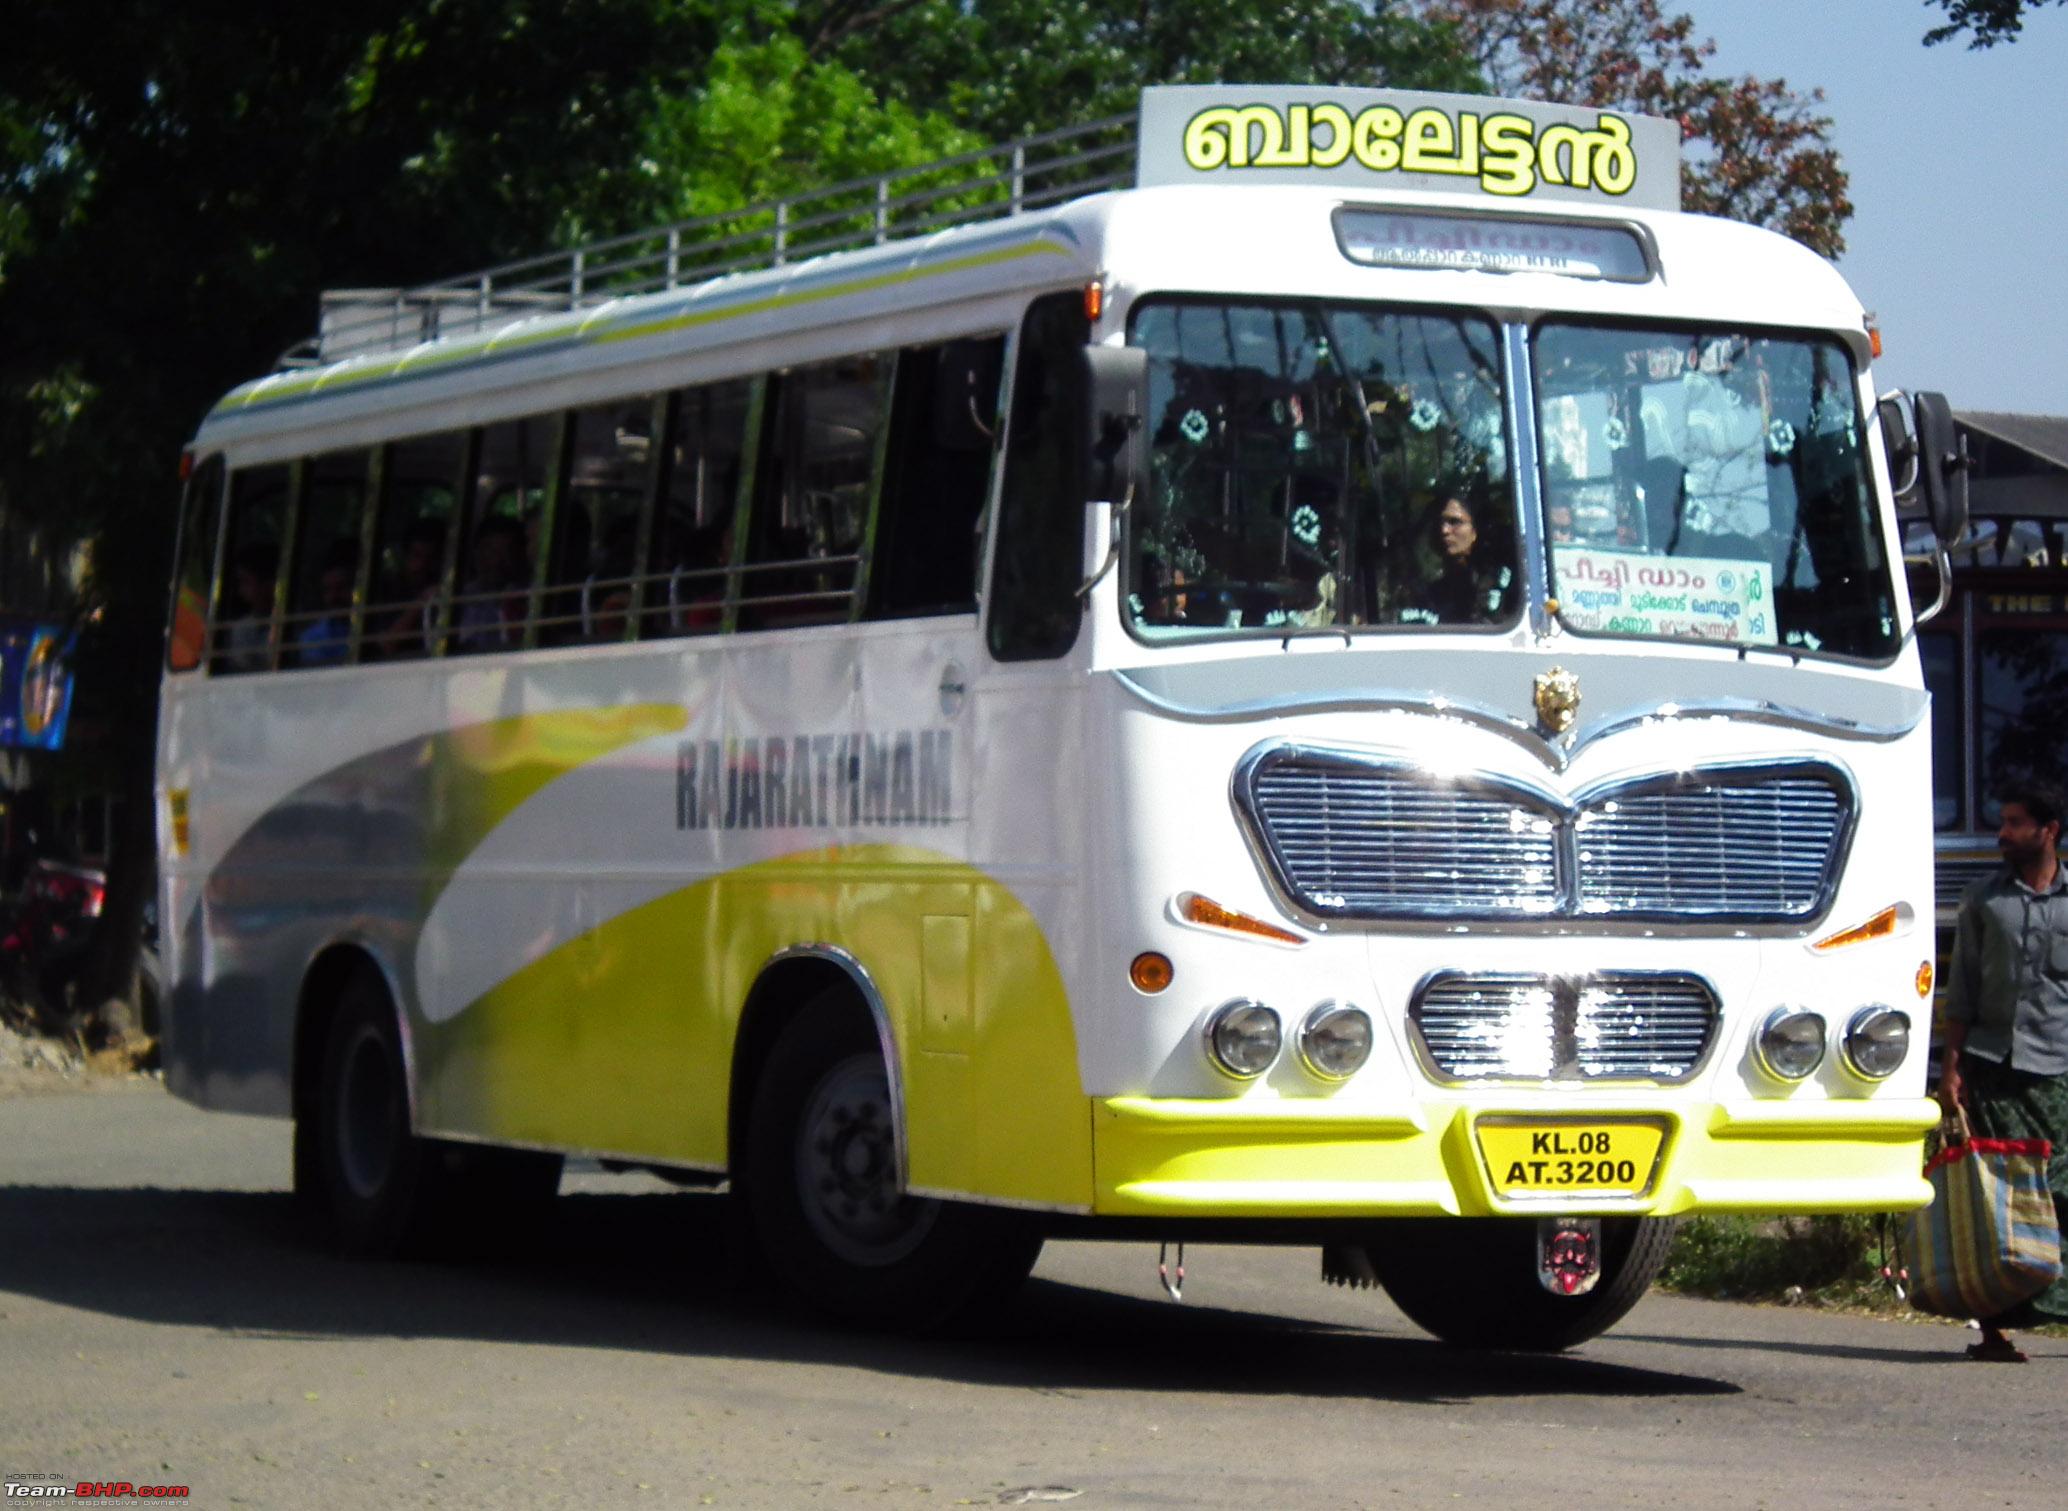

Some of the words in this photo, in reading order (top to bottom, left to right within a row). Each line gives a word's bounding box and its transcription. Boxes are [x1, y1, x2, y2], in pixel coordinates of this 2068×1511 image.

[1183, 102, 1637, 195] ബാലേട്ടൻ
[1532, 1132, 1611, 1155] KL.08
[1505, 1160, 1636, 1184] AT.3200
